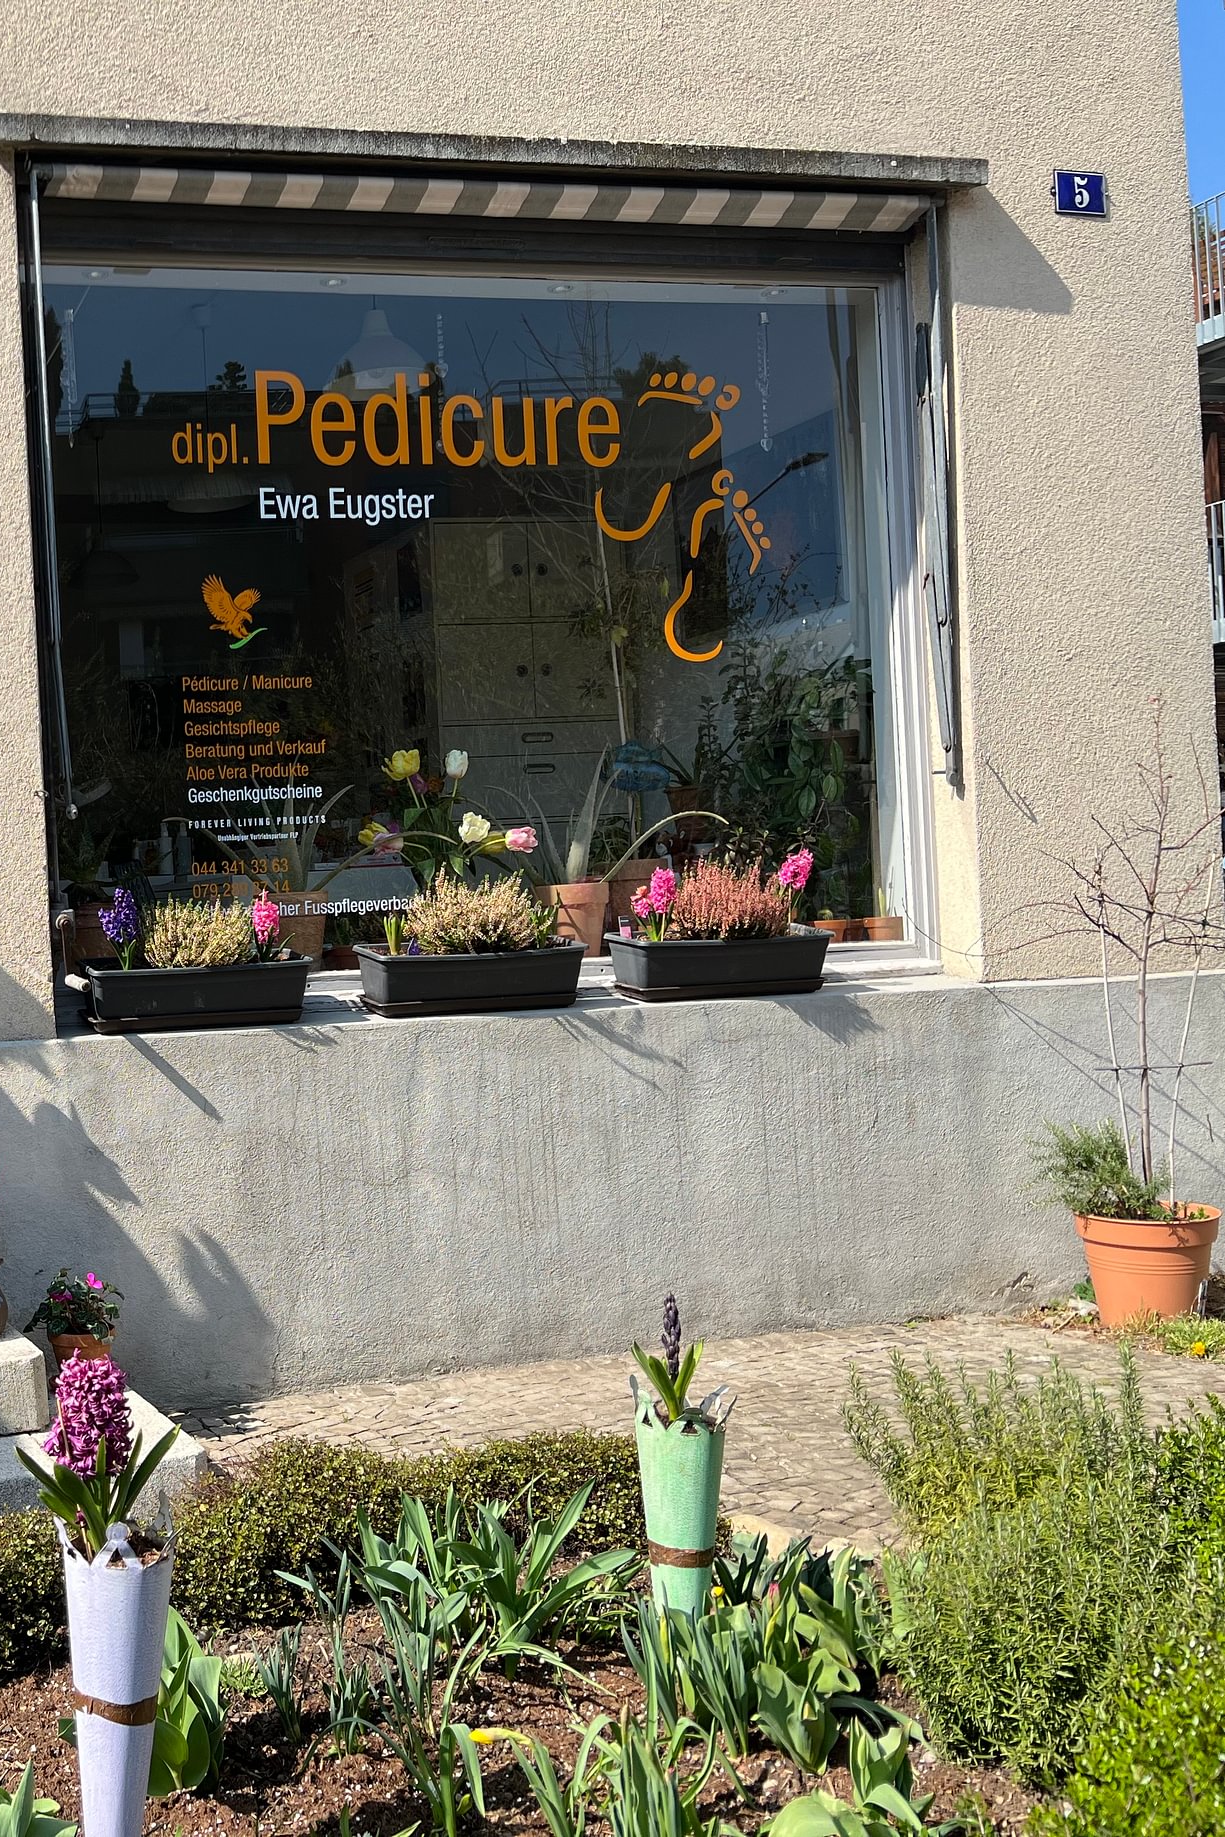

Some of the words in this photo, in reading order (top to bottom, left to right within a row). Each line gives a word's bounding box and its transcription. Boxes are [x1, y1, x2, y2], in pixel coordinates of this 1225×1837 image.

[1074, 176, 1090, 208] 5
[171, 421, 250, 474] dipl.
[254, 369, 621, 468] Pedicure
[259, 487, 319, 521] Ewa
[329, 486, 435, 526] Eugster
[182, 675, 239, 692] Pédicure
[252, 674, 313, 690] Manicure
[183, 699, 242, 716] Massage
[184, 719, 281, 738] Gesichtspflege
[185, 743, 245, 760] Beratung
[249, 741, 274, 756] und
[277, 739, 326, 755] Verkauf
[186, 766, 215, 781] Aloe
[218, 765, 248, 780] Vera
[251, 762, 309, 779] Produkte
[188, 784, 323, 804] Geschenkgutscheine
[188, 818, 232, 829] FOREVER
[238, 817, 271, 828] LIVING
[276, 815, 326, 827] PRODUCTS
[191, 861, 217, 877] 044
[221, 859, 245, 875] 341
[251, 858, 268, 874] 33
[272, 857, 289, 873] 63
[192, 882, 218, 899] 079
[274, 879, 291, 893] 14
